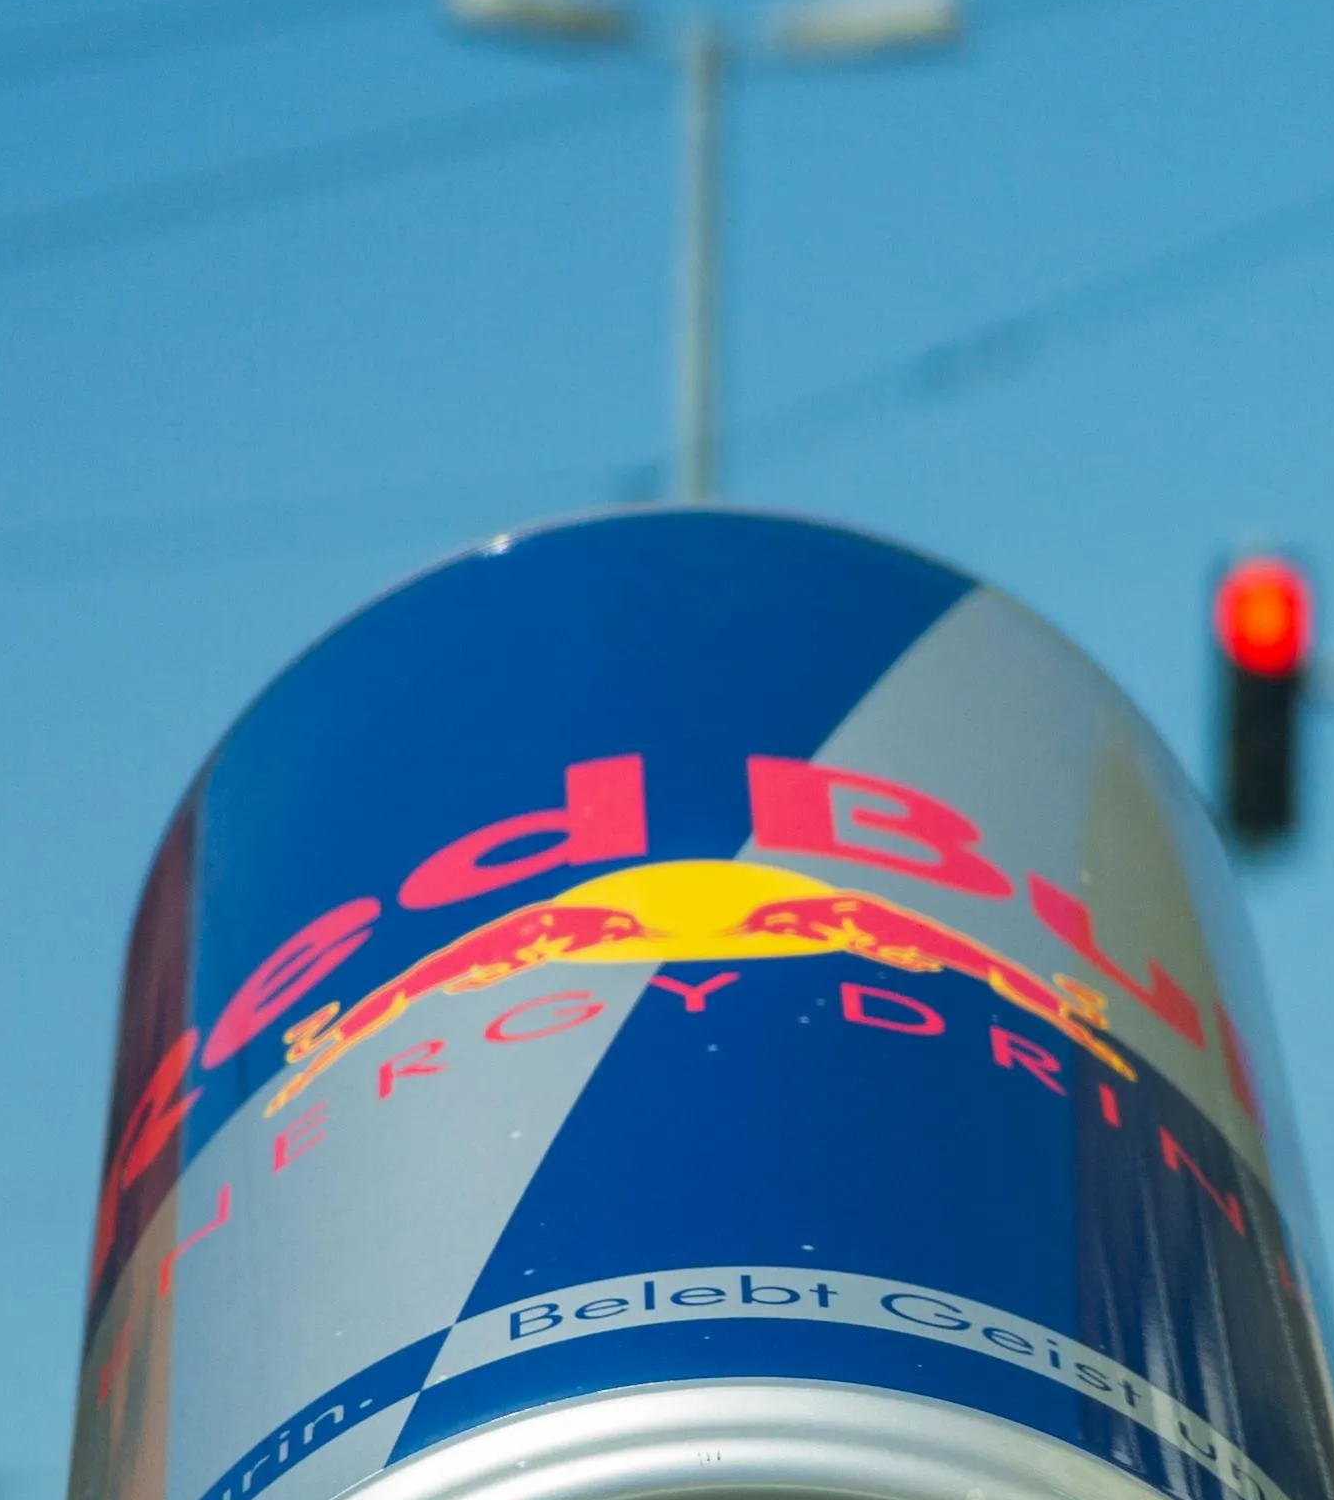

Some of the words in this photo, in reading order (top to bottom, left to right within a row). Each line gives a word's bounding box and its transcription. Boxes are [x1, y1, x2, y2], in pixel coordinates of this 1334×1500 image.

[89, 754, 647, 1304] Red
[746, 754, 1274, 1146] Bul
[509, 1274, 838, 1341] Belebt
[880, 1292, 1143, 1408] Geist
